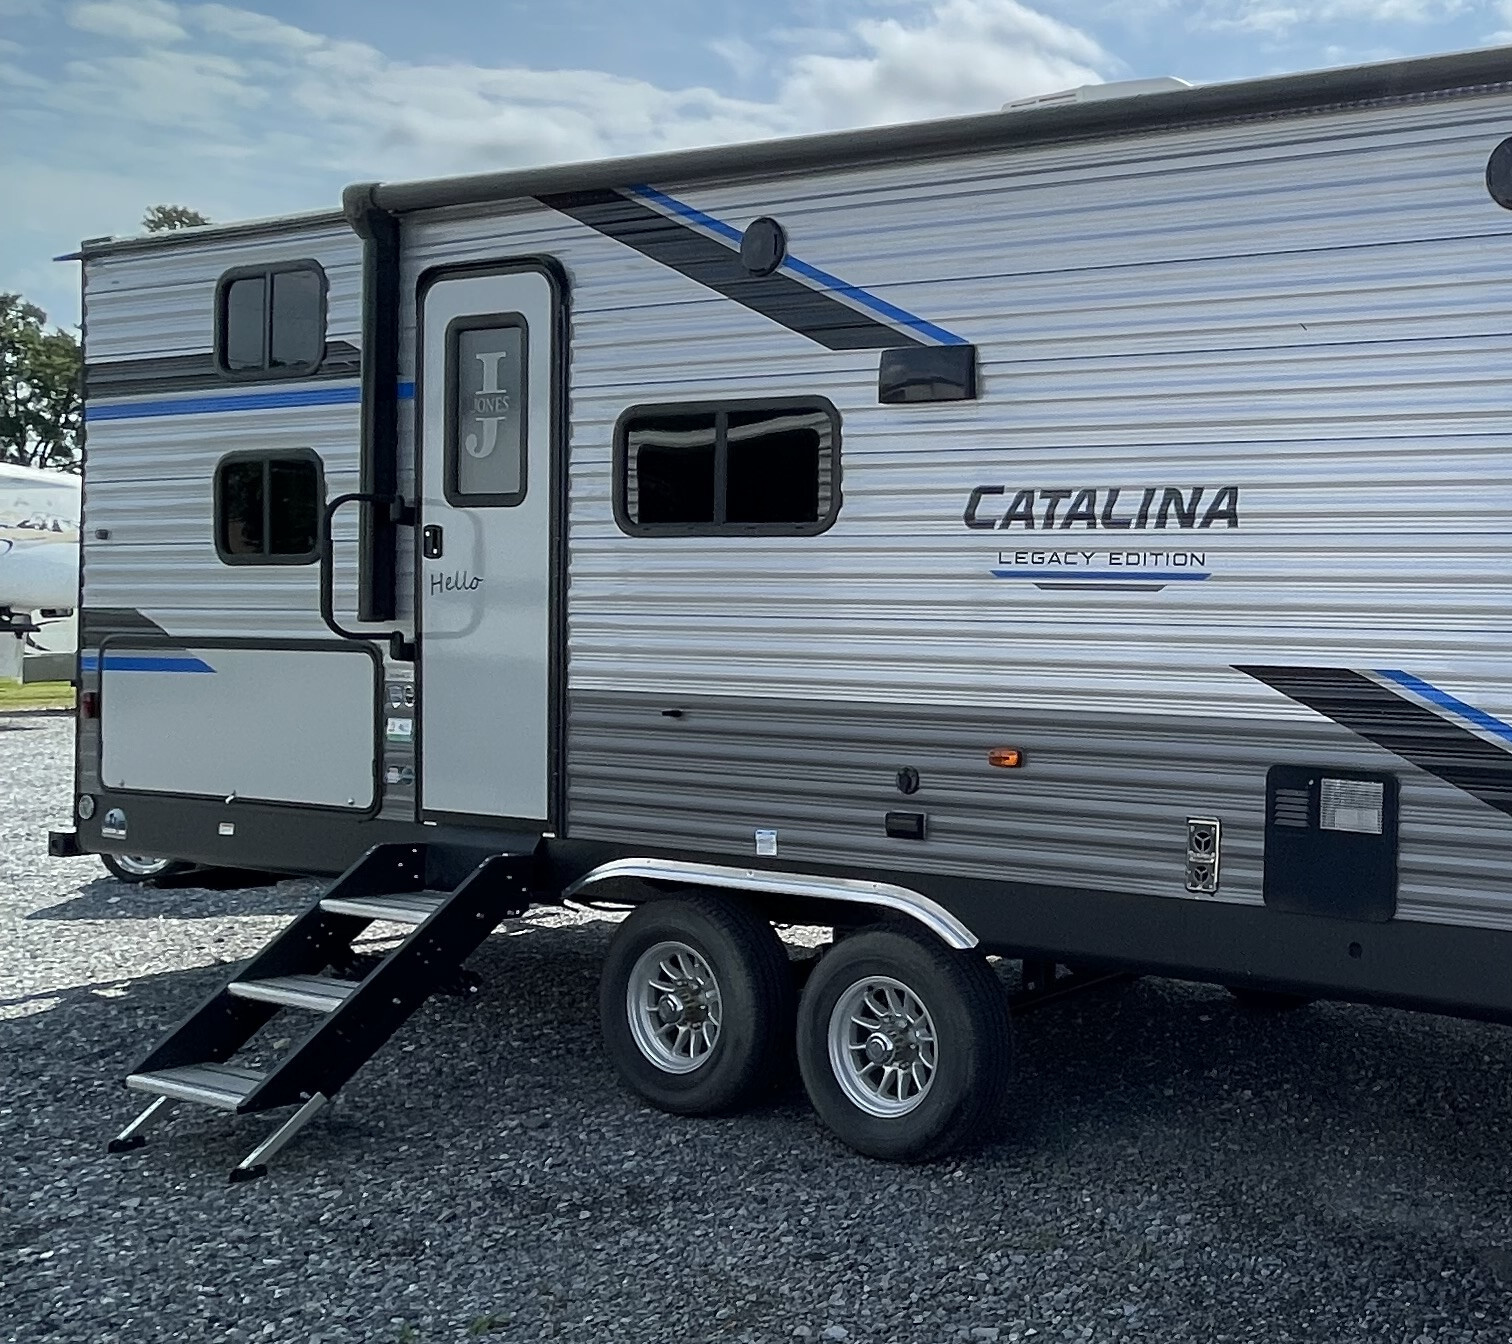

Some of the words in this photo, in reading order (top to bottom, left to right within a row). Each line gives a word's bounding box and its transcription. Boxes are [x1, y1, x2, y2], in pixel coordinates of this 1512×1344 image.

[962, 485, 1239, 530] CATALINA
[998, 551, 1097, 566] LEGACY
[1108, 552, 1206, 567] EDITION
[430, 570, 484, 596] Hello
